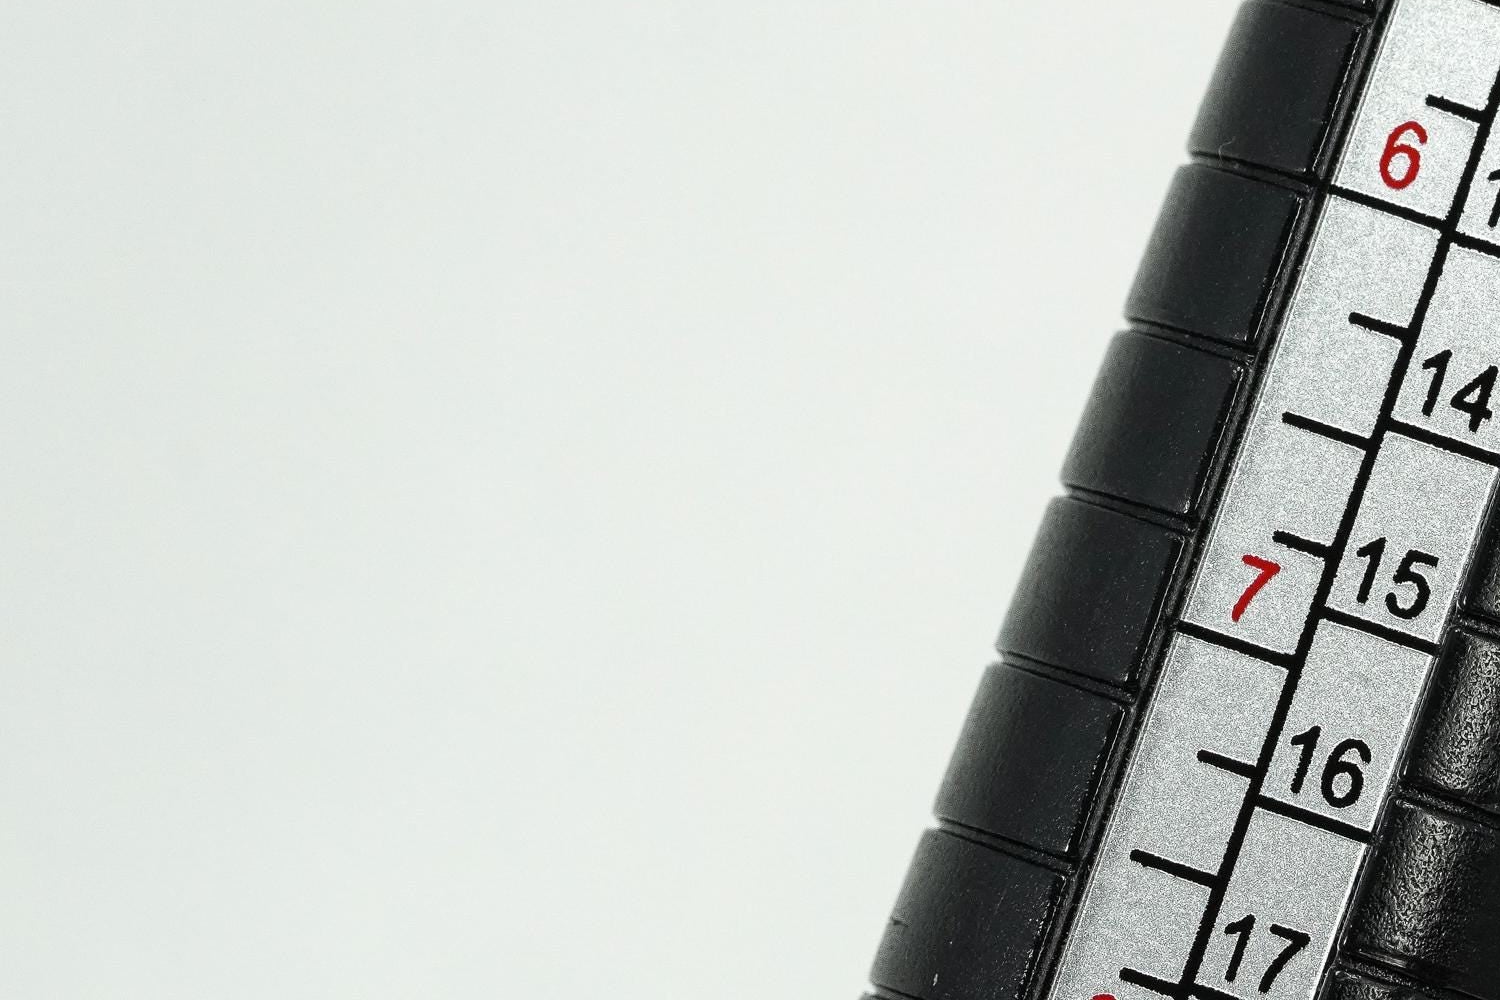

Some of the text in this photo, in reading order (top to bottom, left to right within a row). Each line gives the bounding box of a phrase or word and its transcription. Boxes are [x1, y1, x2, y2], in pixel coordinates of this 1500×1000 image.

[1379, 120, 1428, 190] 6
[1421, 349, 1499, 435] 14
[1231, 554, 1281, 621] 7
[1356, 536, 1440, 620] 15
[1289, 724, 1372, 809] 16
[1223, 913, 1312, 996] 17
